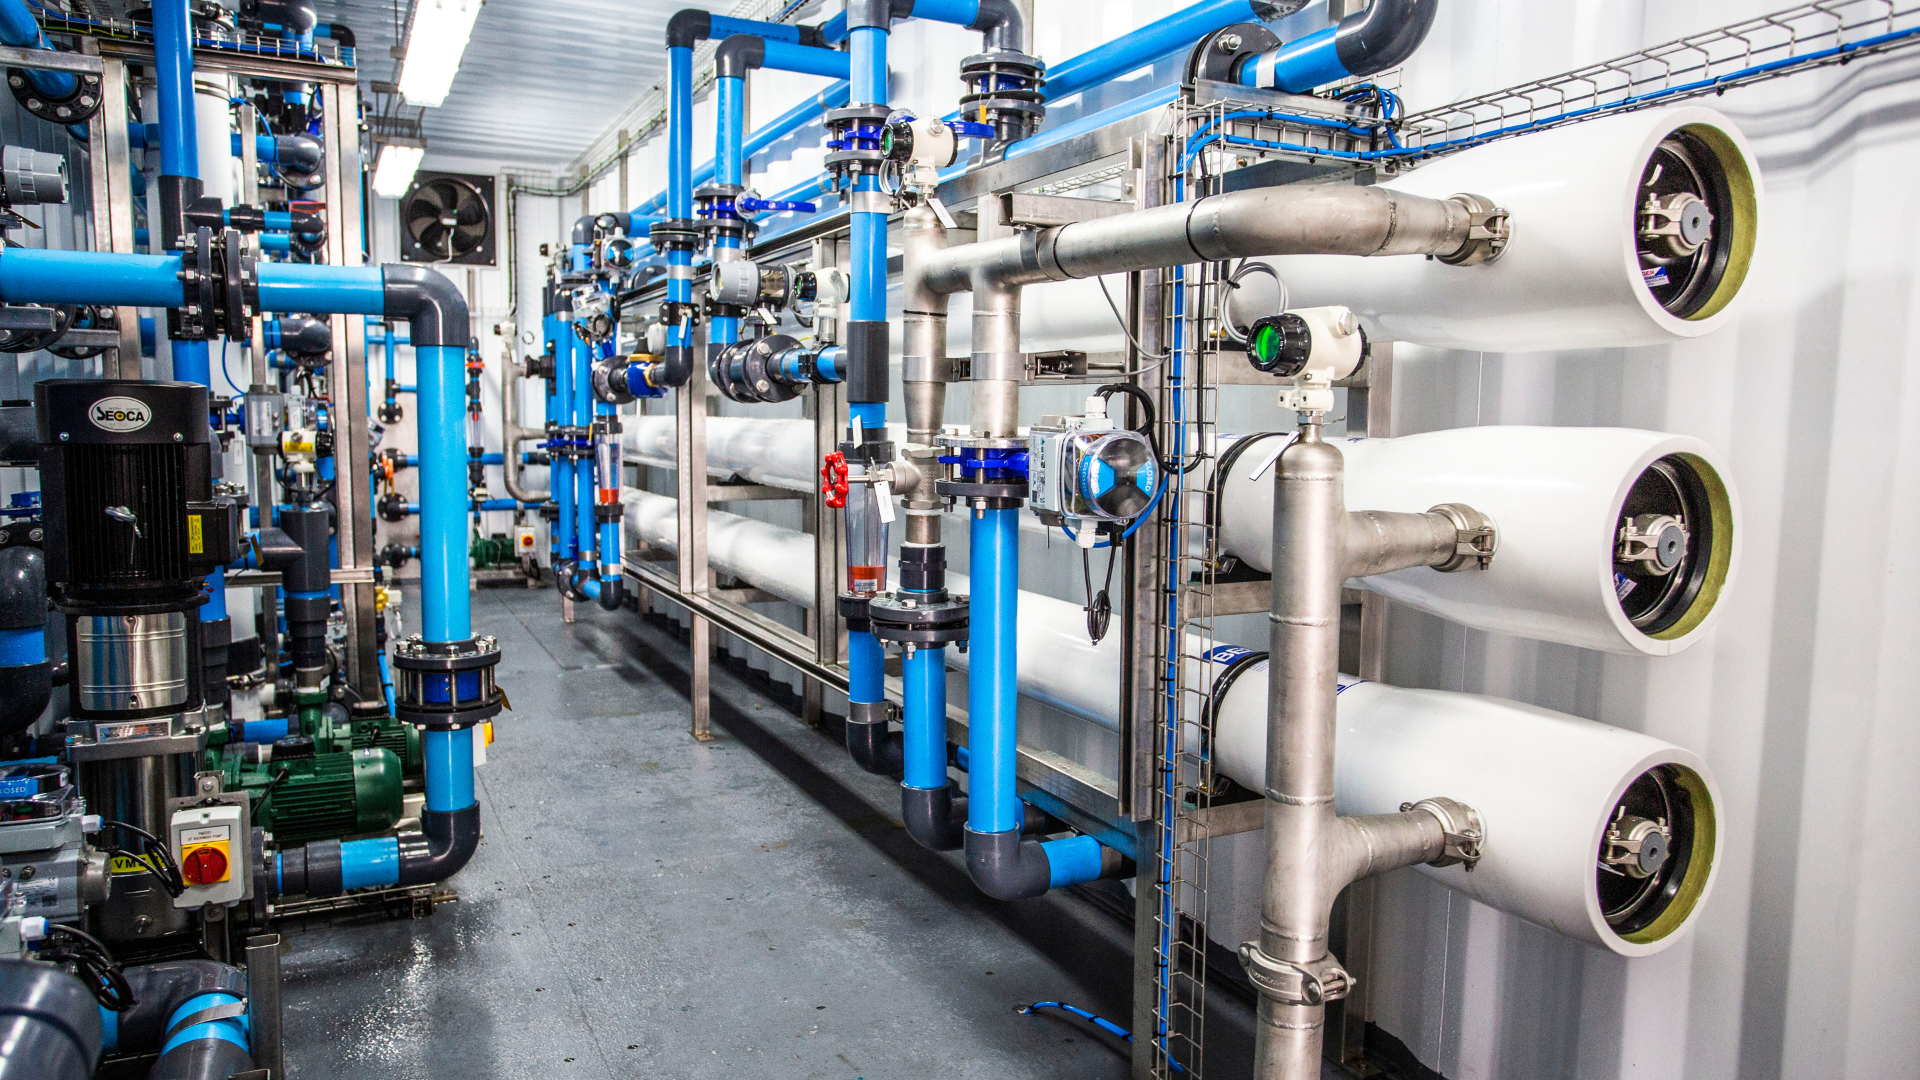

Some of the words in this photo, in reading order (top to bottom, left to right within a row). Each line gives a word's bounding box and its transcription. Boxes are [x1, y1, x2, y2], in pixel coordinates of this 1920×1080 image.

[96, 406, 145, 421] SEOCA
[1144, 461, 1153, 492] CLOSED
[1212, 647, 1254, 662] BE
